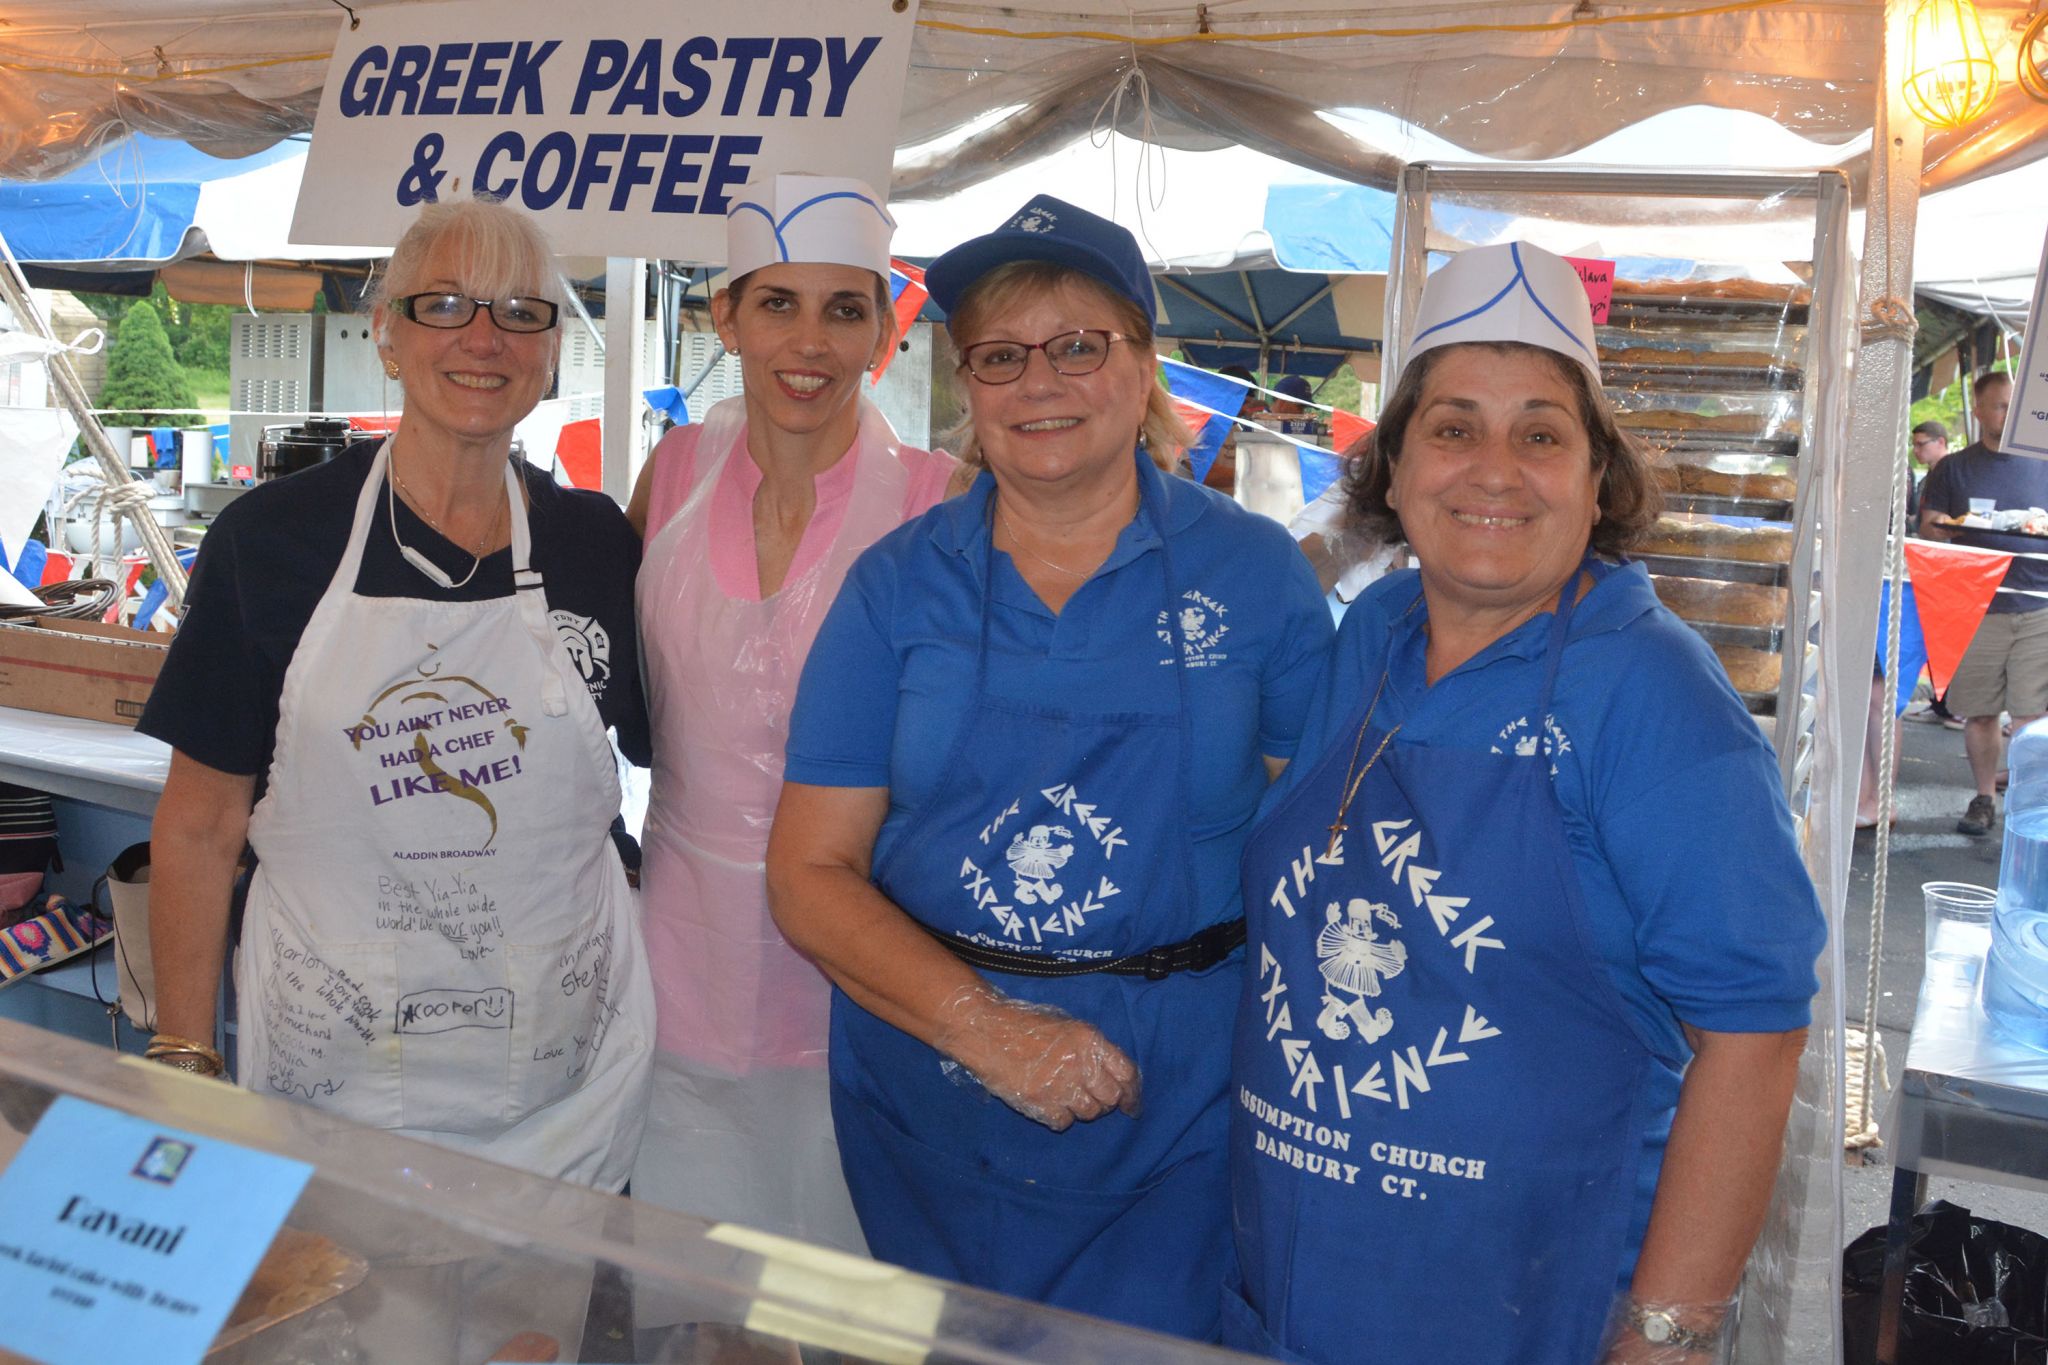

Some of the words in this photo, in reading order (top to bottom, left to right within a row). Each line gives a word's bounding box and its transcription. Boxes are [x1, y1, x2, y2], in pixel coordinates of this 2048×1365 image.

[340, 40, 562, 118] GREEK
[570, 36, 882, 118] PASTRY
[396, 132, 447, 207] &
[472, 131, 763, 214] COFFEE
[1182, 590, 1228, 618] GREEK
[343, 723, 389, 743] YOU
[395, 711, 443, 735] AIN'T
[448, 698, 511, 722] NEVER
[1499, 716, 1528, 739] THE
[380, 748, 423, 768] HAD
[428, 744, 442, 760] A
[445, 731, 495, 753] CHEF
[370, 772, 451, 806] LIKE
[459, 755, 522, 788] ME!
[979, 797, 1020, 845] THE
[1041, 782, 1128, 860] GREEK
[393, 851, 438, 860] ALADDIN
[440, 849, 496, 859] BROADWAY
[378, 875, 420, 898] Best
[378, 901, 390, 911] in
[398, 900, 421, 914] the
[427, 903, 460, 919] whole
[468, 894, 496, 913] wide
[960, 856, 1121, 943] EXPERIENCE
[1270, 834, 1345, 919] THE
[1372, 818, 1506, 974] GREEK
[286, 971, 305, 992] the
[1260, 942, 1502, 1119] EXPERIENCE
[1255, 1130, 1360, 1184] DANBURY
[1381, 1174, 1427, 1200] CT.
[1370, 1141, 1486, 1180] CHURCH
